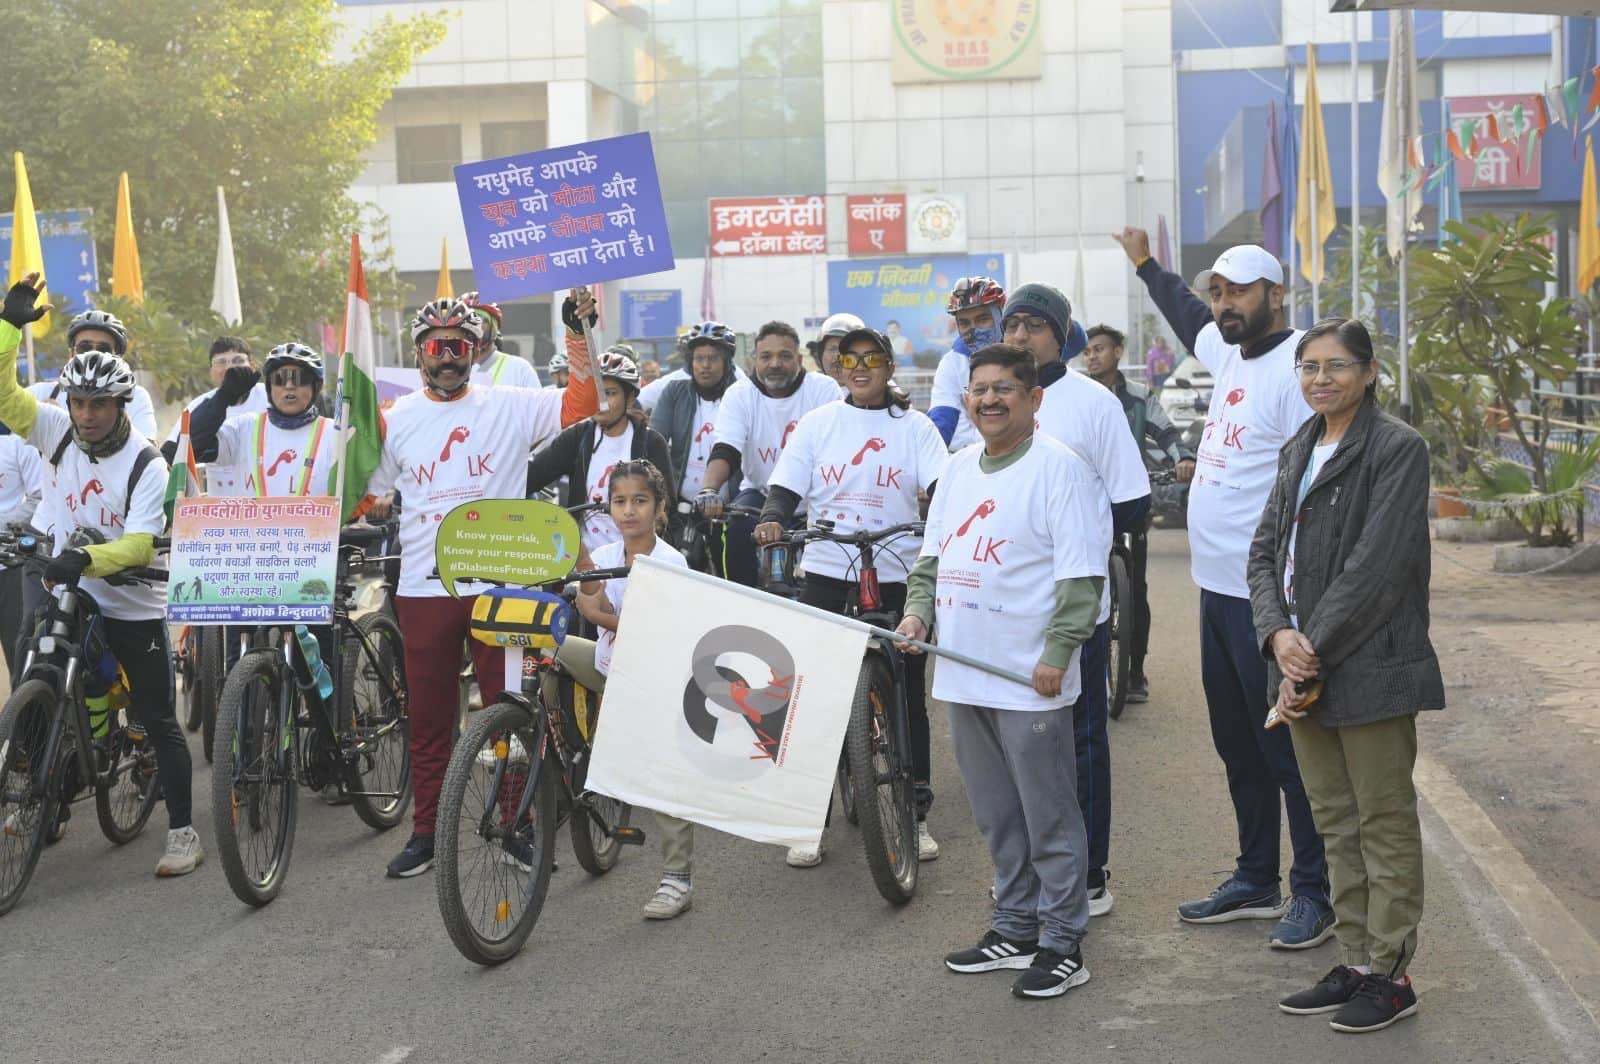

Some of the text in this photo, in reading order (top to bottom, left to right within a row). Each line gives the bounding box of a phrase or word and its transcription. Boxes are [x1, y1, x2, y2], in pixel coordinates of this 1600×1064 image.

[473, 151, 597, 195] मधुमेह आपके
[480, 172, 637, 226] खून को मीठा और
[713, 198, 826, 231] इमरजेंसी
[850, 198, 903, 222] ब्लॉक
[488, 203, 636, 249] आपके जीवन को
[741, 231, 826, 253] ट्रॉमा सेंटर
[868, 228, 885, 250] ए
[549, 246, 588, 268] बना
[591, 239, 626, 264] देता
[180, 505, 197, 517] हम
[243, 500, 257, 519] तो
[262, 504, 282, 520] युग
[286, 501, 332, 516] बदलेगा
[456, 529, 540, 545] Know your risk,
[236, 543, 256, 553] भारत
[443, 545, 474, 555] Know
[477, 548, 500, 558] your
[189, 555, 222, 567] पर्यावरण
[255, 555, 290, 567] साइकिल
[450, 562, 549, 577] #DiabetesFreeLife
[232, 573, 250, 584] मुक्त
[254, 572, 275, 582] भारत
[220, 586, 235, 597] और
[240, 587, 262, 597] स्वस्थ
[242, 605, 276, 617] अशोक
[508, 634, 532, 646] SBI
